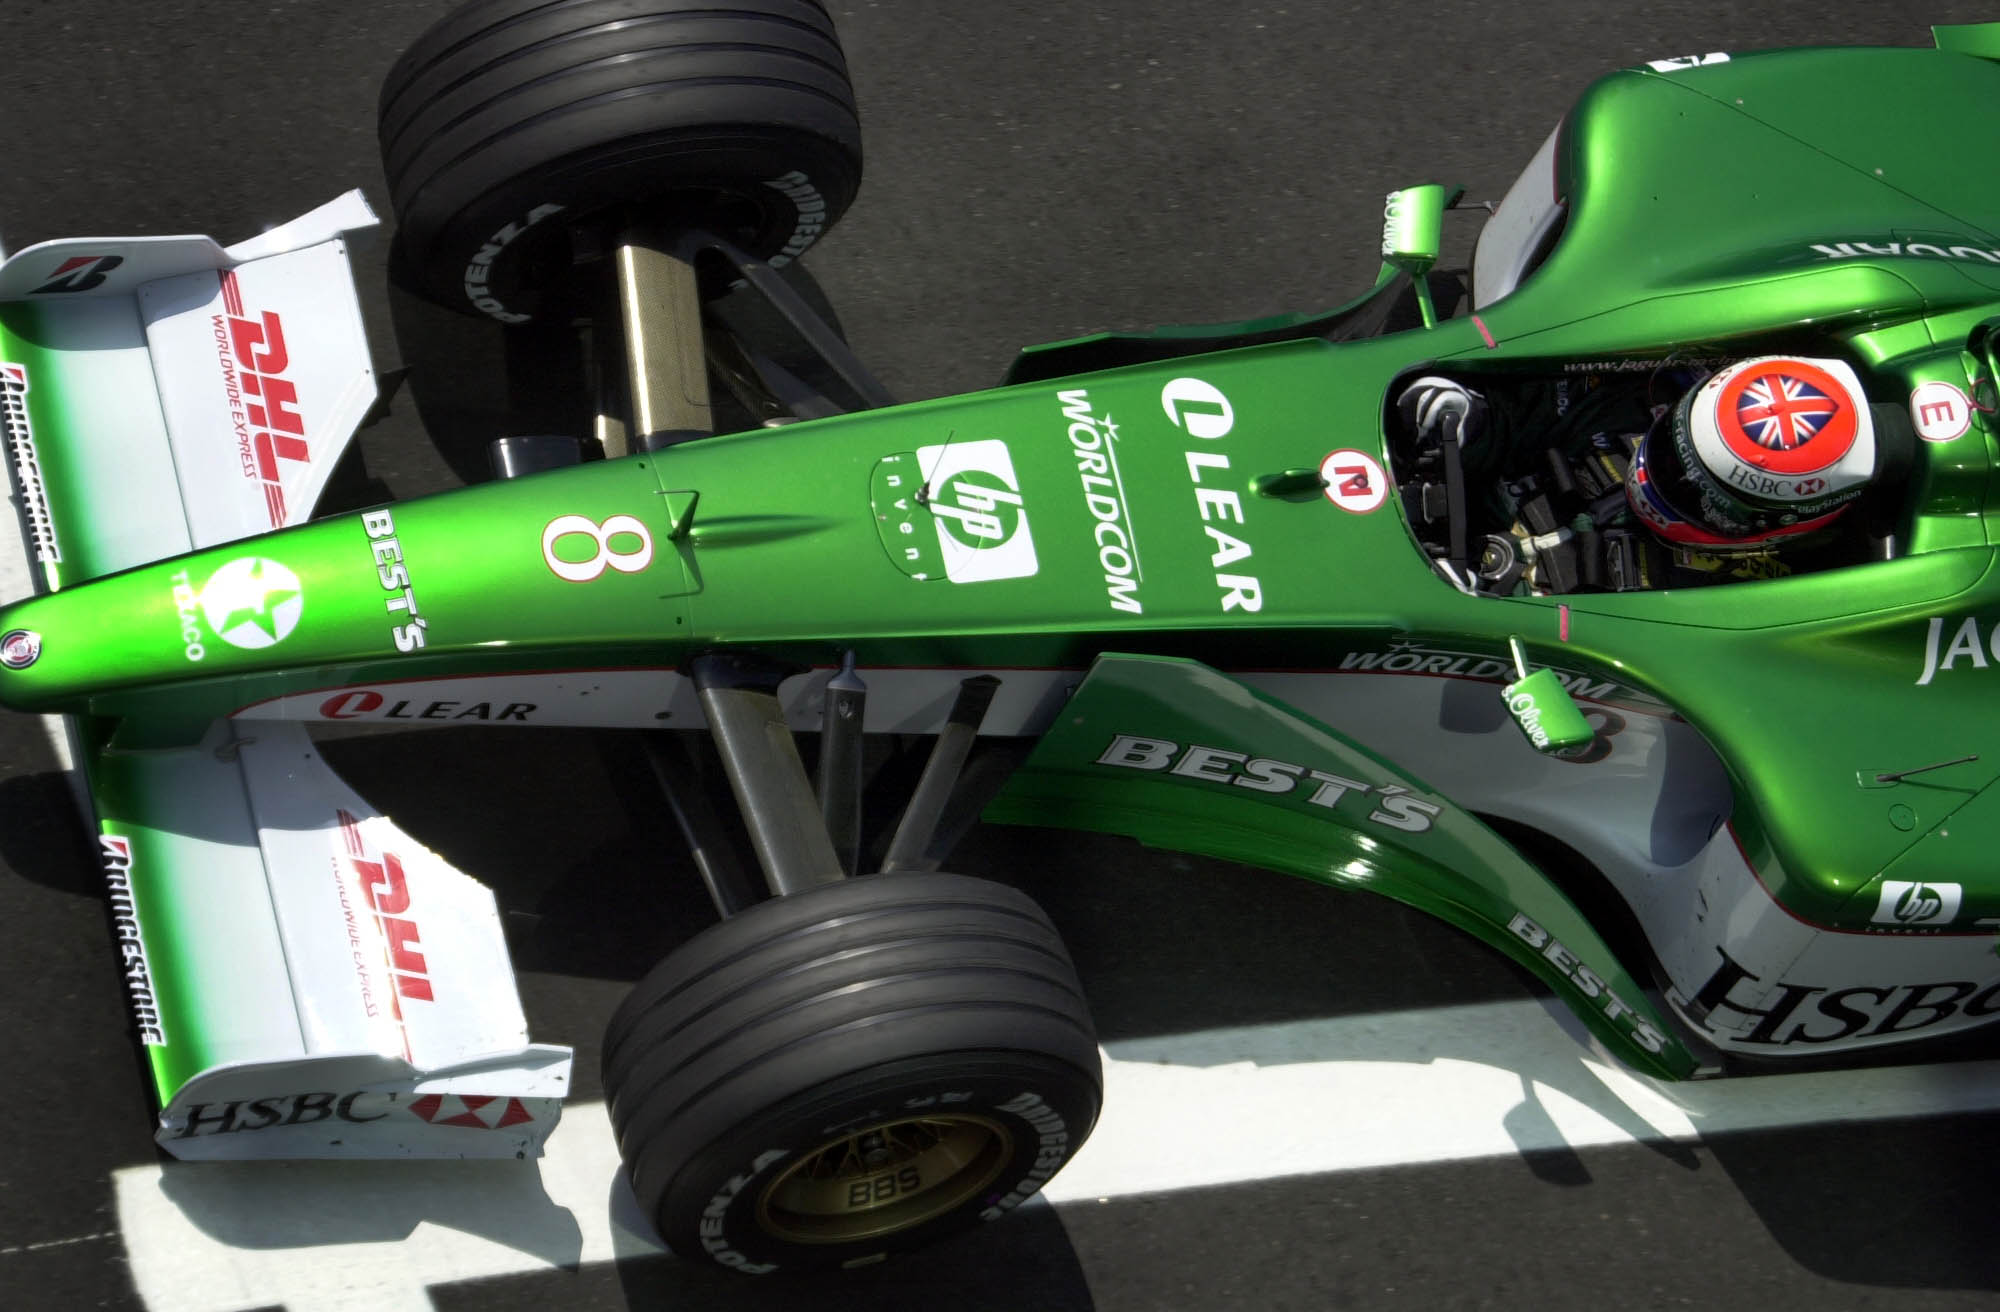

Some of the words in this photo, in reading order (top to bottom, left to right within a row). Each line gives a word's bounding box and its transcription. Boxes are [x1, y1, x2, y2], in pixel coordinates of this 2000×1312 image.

[211, 313, 242, 408] WORLDWIDE
[231, 409, 258, 481] EXPRESS
[227, 310, 311, 483] DHL
[1919, 400, 1955, 427] E
[881, 455, 927, 582] invent
[1057, 389, 1143, 615] WORLDCOM
[1185, 451, 1263, 613] LEAR
[1728, 464, 1793, 498] HSBC
[361, 509, 429, 655] BEST'S
[541, 514, 654, 583] 8
[1915, 616, 2000, 685] JA
[385, 699, 538, 721] LEAR
[1095, 733, 1443, 834] BEST'S
[101, 836, 167, 1047] BRIDGESTONE
[350, 851, 435, 1023] DHL
[171, 1090, 397, 1141] HSBC
[847, 1170, 921, 1208] BBS
